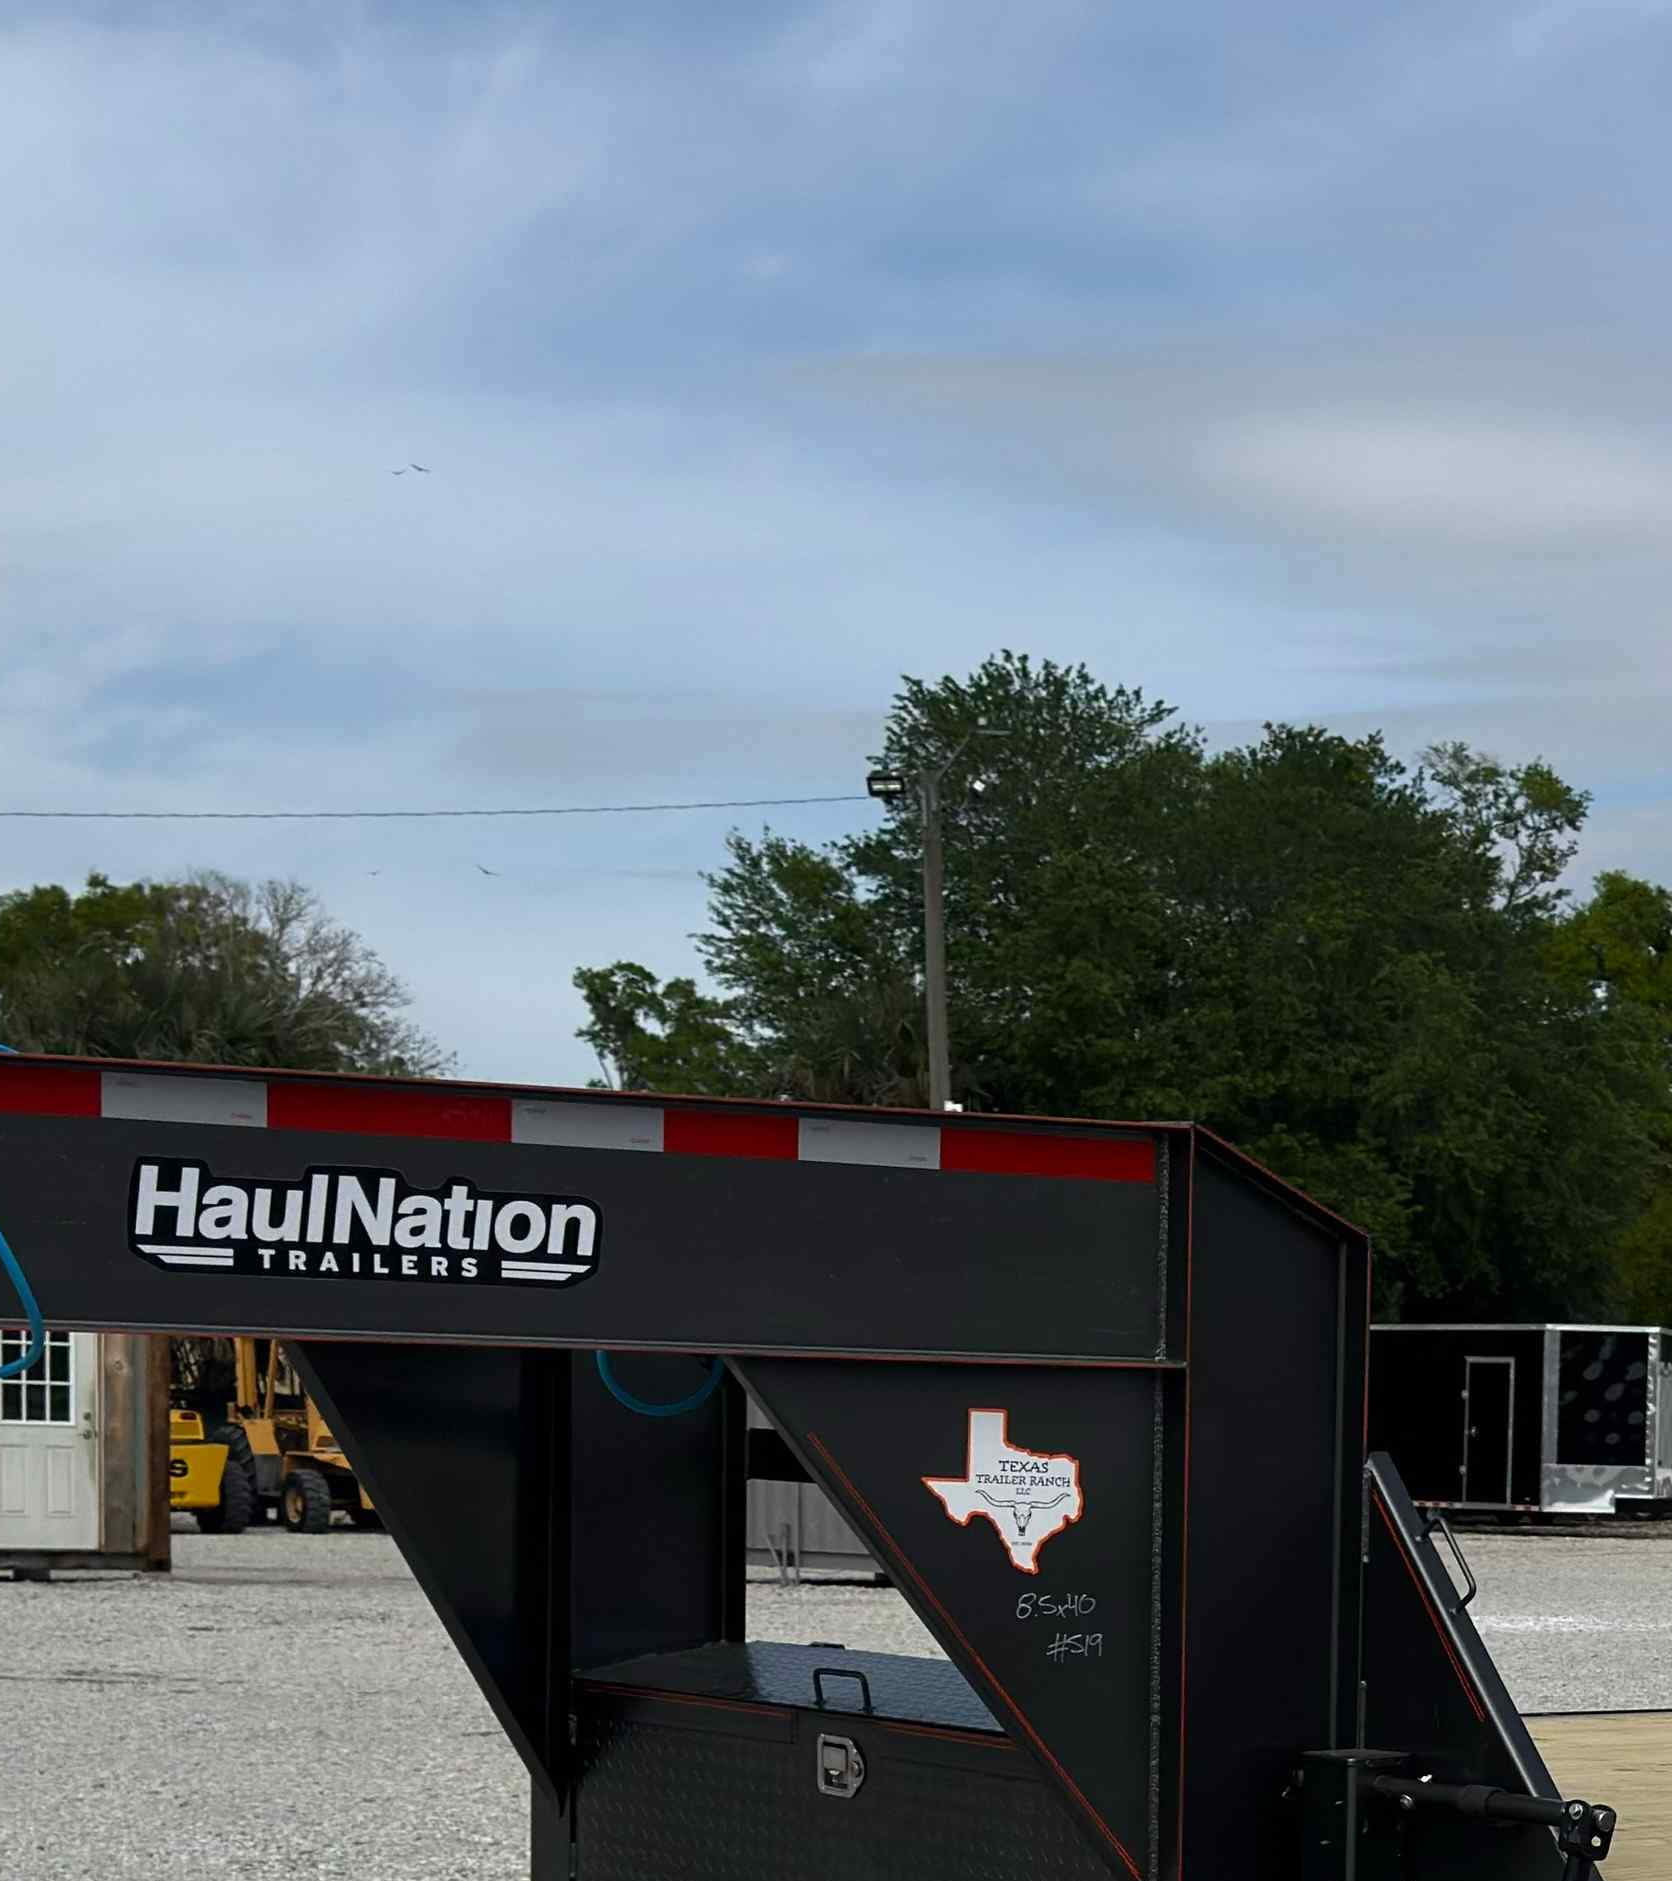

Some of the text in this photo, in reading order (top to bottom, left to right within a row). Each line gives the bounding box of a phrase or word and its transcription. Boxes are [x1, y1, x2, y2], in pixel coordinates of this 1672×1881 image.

[134, 1164, 597, 1257] HaulNation
[258, 1247, 479, 1278] TRAILERS
[998, 1460, 1049, 1474] TEXAS
[975, 1473, 1071, 1488] TRAILER RANCH
[1015, 1487, 1031, 1496] LLC
[1046, 1632, 1103, 1663] #519
